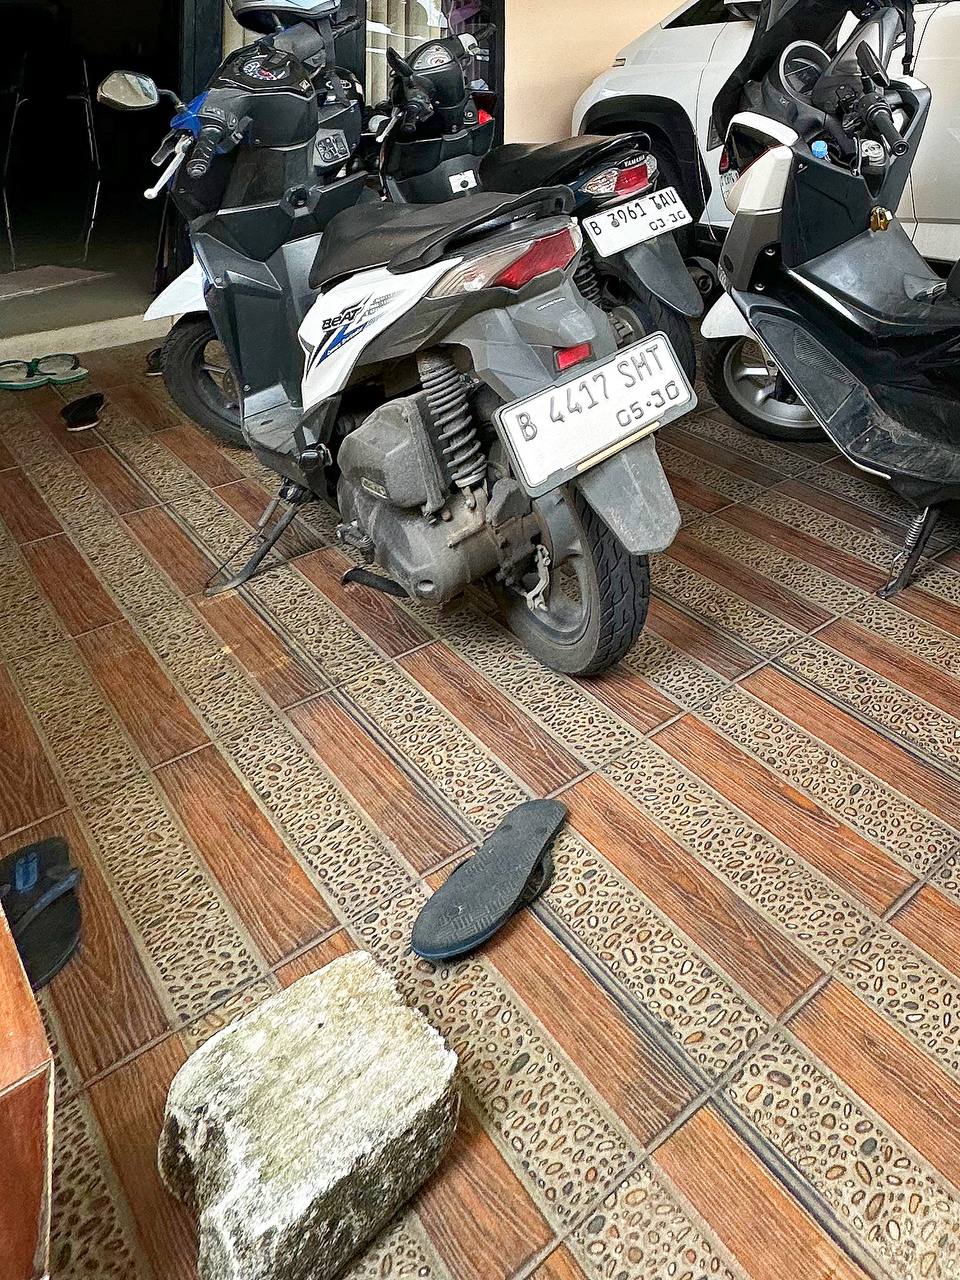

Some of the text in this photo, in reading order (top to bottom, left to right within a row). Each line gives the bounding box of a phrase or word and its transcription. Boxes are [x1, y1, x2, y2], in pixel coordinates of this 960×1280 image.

[589, 221, 602, 236] B
[607, 202, 647, 228] 3961
[515, 412, 538, 442] B
[549, 372, 609, 423] 4417
